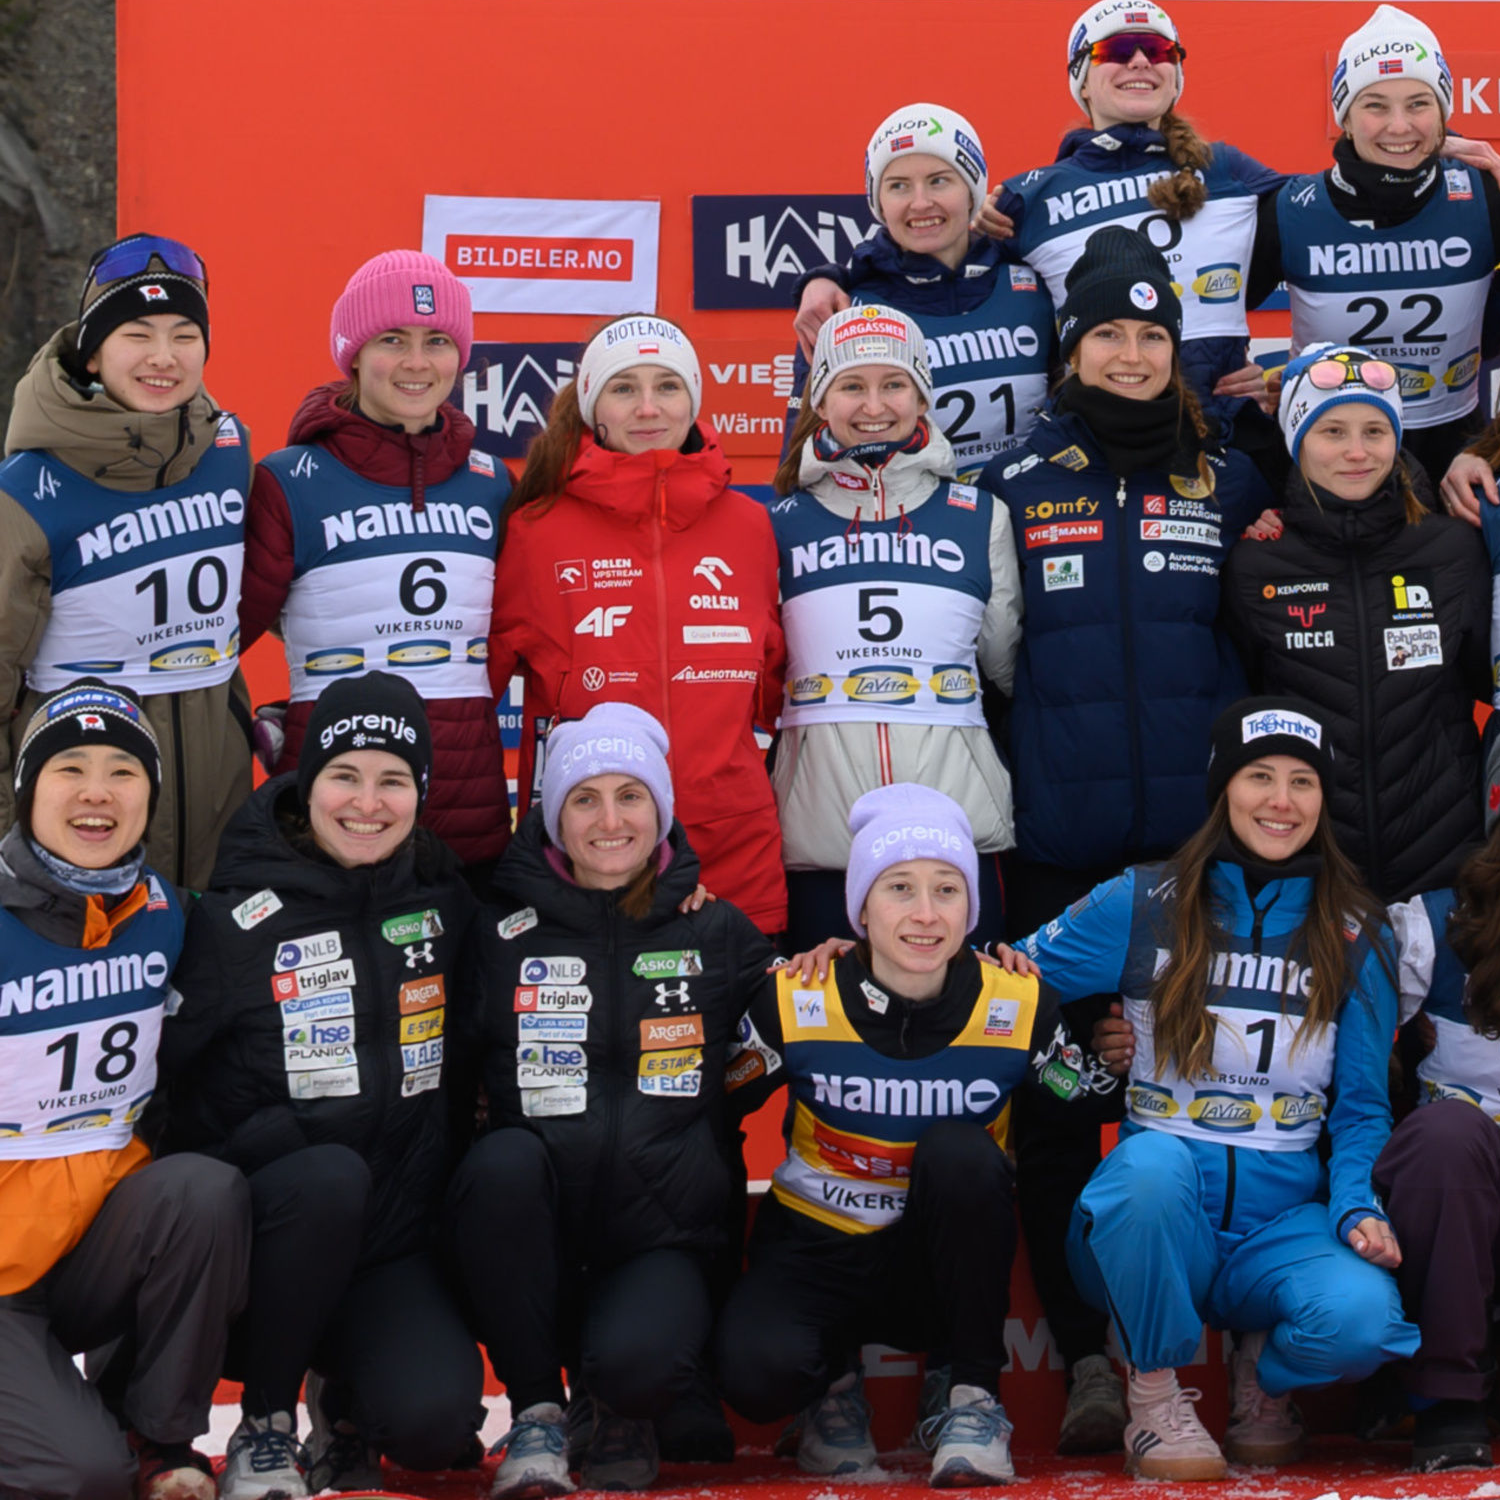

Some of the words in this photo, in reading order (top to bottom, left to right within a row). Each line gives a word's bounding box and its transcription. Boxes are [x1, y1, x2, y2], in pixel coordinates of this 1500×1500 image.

[457, 246, 622, 270] BILDELER.NO
[1307, 236, 1472, 276] Nammo
[1346, 294, 1447, 345] 22
[606, 320, 682, 346] BIOTEAQUE
[834, 321, 907, 342] HARGASSNER
[925, 325, 1039, 371] ammo
[935, 383, 1016, 444] 21
[1025, 496, 1099, 519] somfy
[1168, 499, 1204, 510] CAISSE
[77, 488, 244, 567] Nammo
[321, 502, 494, 551] Nammo
[1028, 525, 1098, 542] VIESSMANN
[1162, 521, 1195, 536] Jean
[592, 558, 632, 569] ORLEN
[791, 531, 965, 579] Nammo
[593, 569, 643, 579] UPSTREAM
[594, 579, 633, 589] NORWAY
[135, 555, 228, 627] 10
[398, 557, 448, 616] 6
[1277, 582, 1329, 595] KEMPOWER
[689, 595, 739, 611] ORLEN
[574, 605, 633, 638] 4F
[857, 588, 904, 643] 5
[136, 615, 226, 646] VIKERSUND
[375, 619, 464, 635] VIKERSUND
[1387, 628, 1437, 644] Pohjolan
[1285, 630, 1335, 649] TOCCA
[836, 646, 923, 661] VIKERSUND
[321, 714, 417, 749] gorenje
[561, 737, 647, 774] gorenje
[871, 825, 963, 858] gorenje
[304, 939, 338, 959] NLB
[300, 968, 350, 989] triglav
[550, 964, 582, 978] NLB
[0, 951, 168, 1017] Nammo
[405, 984, 440, 1003] ARGETA
[540, 992, 588, 1008] triglav
[311, 1024, 350, 1044] hse
[648, 1022, 697, 1041] ARGETA
[46, 1021, 139, 1093] 18
[289, 1047, 351, 1059] PLANICA
[418, 1042, 442, 1064] ELES
[543, 1046, 582, 1065] hse
[521, 1067, 584, 1077] PLANICA
[660, 1075, 699, 1092] ELES
[38, 1084, 127, 1111] VIKERSUND
[811, 1073, 1000, 1116] Nammo
